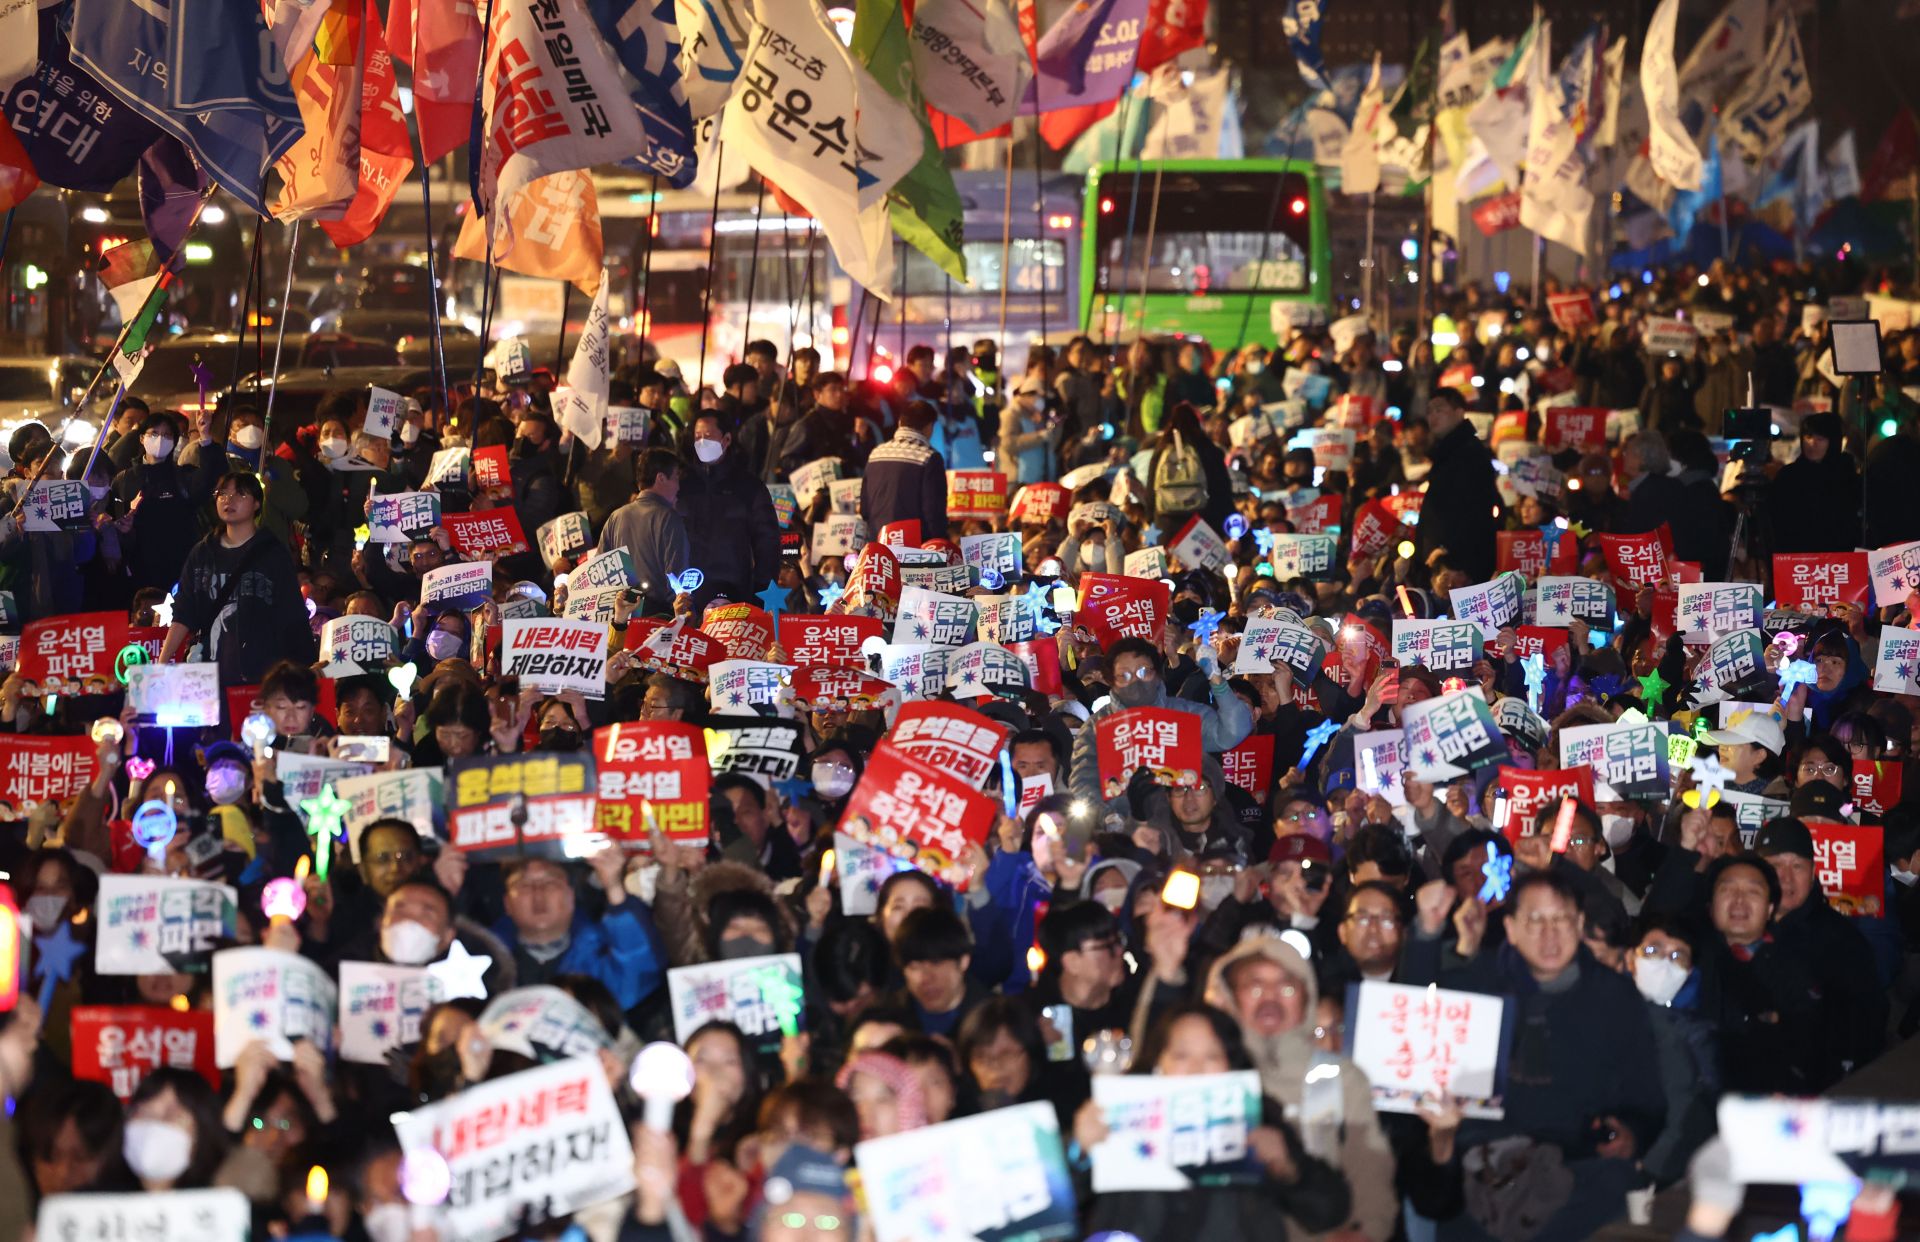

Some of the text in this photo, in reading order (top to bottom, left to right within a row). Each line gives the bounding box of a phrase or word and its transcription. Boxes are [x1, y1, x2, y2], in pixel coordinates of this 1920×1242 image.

[77, 90, 112, 124] 위한
[11, 89, 101, 164] 연대
[49, 482, 82, 502] 즉각
[51, 501, 84, 521] 파면
[373, 502, 398, 515] 내란수괴
[400, 495, 433, 513] 즉각
[374, 511, 399, 523] 윤석열
[401, 511, 434, 532] 파면
[454, 518, 508, 537] 김건희도
[459, 532, 512, 551] 구속하라
[981, 534, 1014, 560] 즉각
[1299, 540, 1329, 558] 즉각
[454, 568, 485, 581] 윤석열은
[587, 551, 623, 581] 해체
[934, 564, 972, 586] 즉각
[1299, 556, 1329, 573] 파면
[1627, 563, 1663, 585] 파면
[1792, 563, 1849, 586] 윤석열
[442, 579, 488, 599] 퇴진하라!
[1486, 574, 1517, 608] 즉각
[1542, 583, 1572, 593] 내란수괴
[1542, 590, 1571, 602] 윤석열
[1572, 582, 1609, 600] 즉각
[1682, 592, 1713, 605] 내란수괴
[1714, 586, 1755, 610] 즉각
[1801, 584, 1841, 605] 파면
[569, 599, 596, 616] 윤석열
[570, 594, 598, 607] 내란수괴
[1457, 591, 1486, 609] 내란수괴
[1459, 602, 1489, 619] 윤석열
[1572, 599, 1609, 618] 파면
[1682, 599, 1712, 616] 윤석열
[936, 601, 975, 624] 즉각
[1105, 598, 1156, 630] 윤석열
[1492, 600, 1520, 629] 파면
[1714, 608, 1755, 632] 파면
[352, 621, 391, 643] 해체
[512, 626, 604, 654] 내란세력
[702, 622, 769, 643] 파면하고
[803, 625, 859, 647] 윤석열
[932, 623, 968, 645] 파면
[1000, 616, 1034, 642] 파면
[1245, 633, 1277, 647] 윤석열
[1248, 627, 1280, 637] 내란수괴
[1397, 628, 1431, 642] 내란수괴
[1431, 624, 1474, 650] 즉각
[36, 625, 107, 656] 윤석열
[1277, 628, 1321, 655] 즉각
[1397, 638, 1431, 654] 윤석열
[1712, 631, 1754, 667] 즉각
[1885, 639, 1920, 649] 내란수괴
[352, 642, 391, 662] 하라
[793, 646, 831, 665] 즉각
[983, 648, 1022, 673] 즉각
[1270, 646, 1316, 672] 파면
[1430, 648, 1474, 672] 파면
[1883, 648, 1918, 662] 윤석열
[47, 652, 97, 679] 파면
[506, 653, 604, 680] 제압하자!
[714, 668, 746, 685] 내란수괴
[1715, 652, 1756, 688] 파면
[715, 678, 746, 696] 윤석열
[982, 667, 1025, 687] 파면
[819, 681, 864, 698] 파면
[1429, 694, 1479, 736] 즉각
[892, 716, 1000, 755] 윤석열을
[1112, 719, 1179, 752] 윤석열
[1438, 723, 1492, 764] 파면
[1566, 736, 1604, 752] 내란수괴
[1606, 726, 1657, 759] 즉각
[6, 751, 95, 777] 새봄에는
[904, 745, 990, 783] 면하라!
[1121, 745, 1167, 770] 파면
[1565, 746, 1604, 767] 윤석열
[1607, 754, 1658, 785] 파면
[6, 775, 92, 801] 새나라로
[456, 756, 586, 807] 윤석열을
[599, 770, 682, 800] 윤석열
[894, 771, 968, 827] 윤석열
[869, 790, 968, 860] 즉각 구속
[1379, 991, 1473, 1045] 윤석열
[97, 1025, 199, 1072] 윤석열
[431, 1076, 592, 1162] 내란세력
